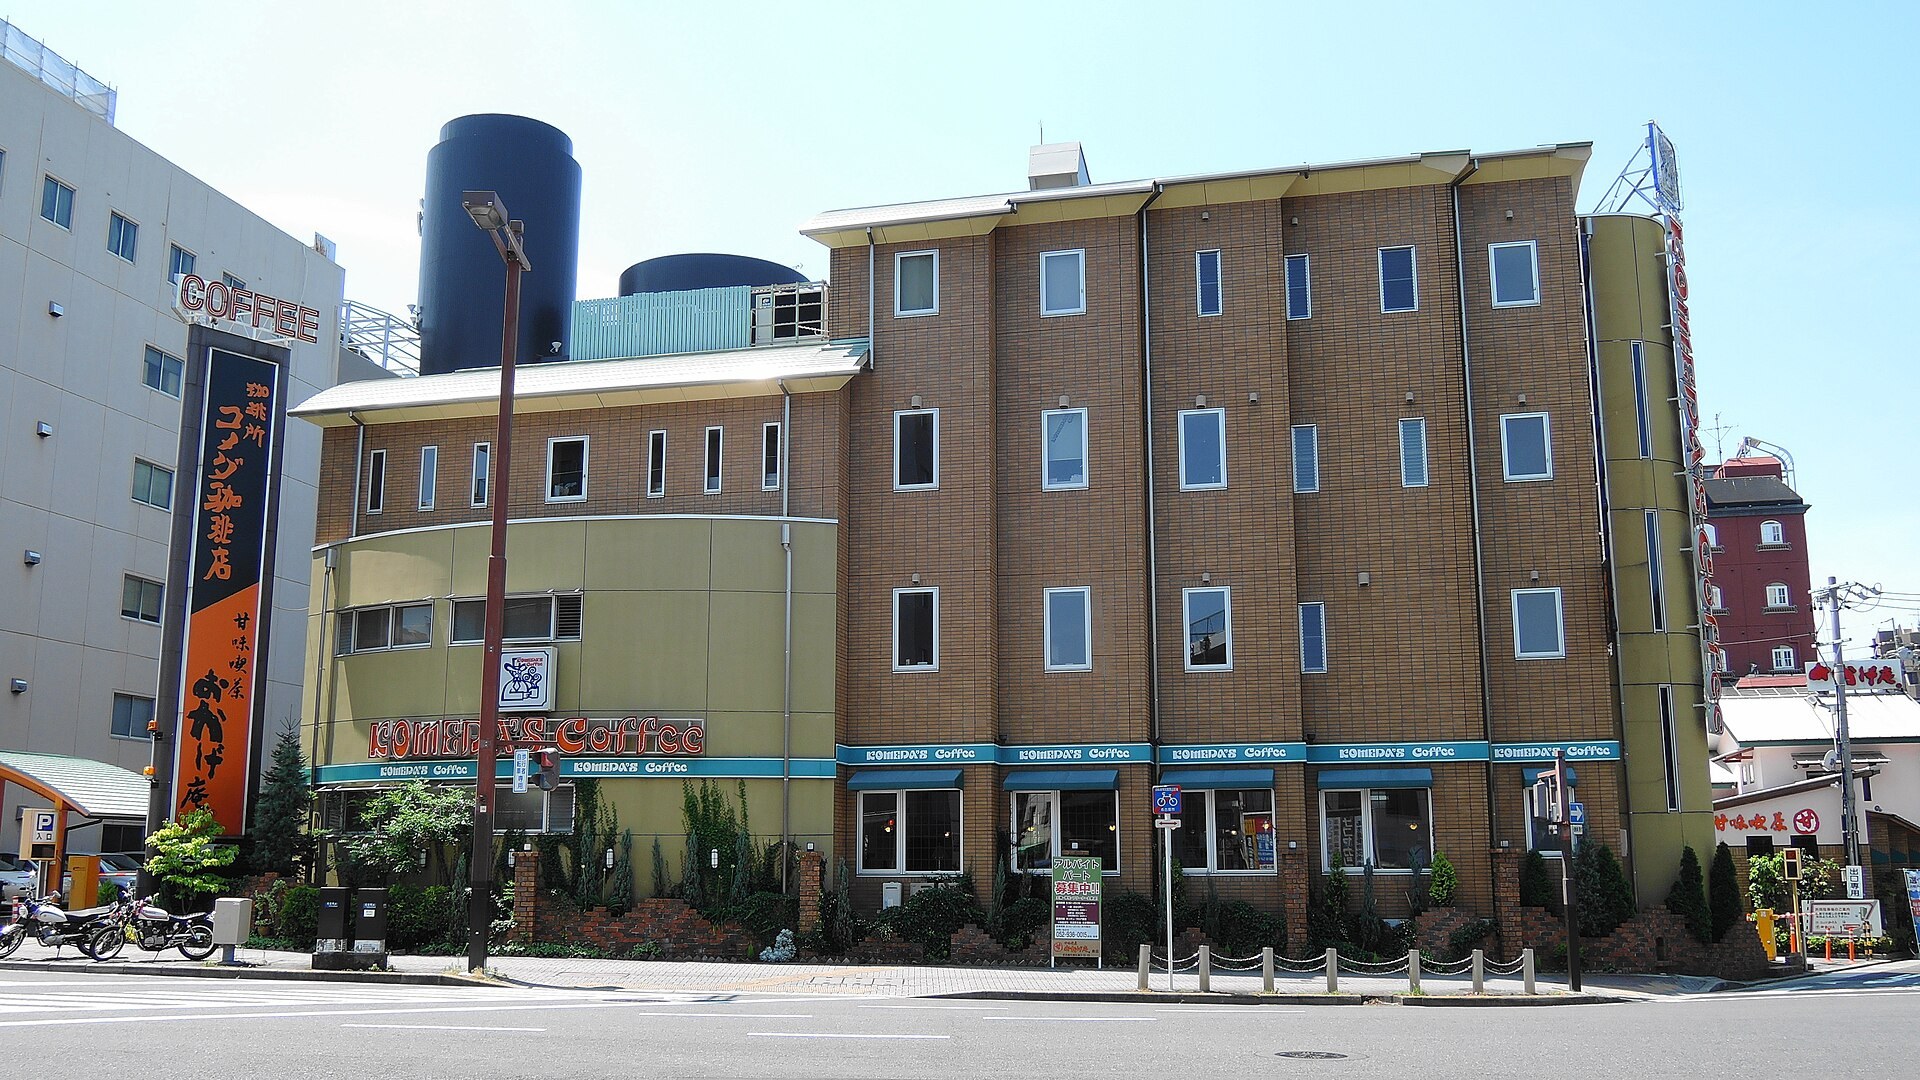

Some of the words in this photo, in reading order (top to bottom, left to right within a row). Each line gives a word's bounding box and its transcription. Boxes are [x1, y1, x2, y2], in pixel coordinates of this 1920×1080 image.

[181, 274, 319, 344] COFFEE
[243, 382, 269, 448] 珈琲所
[203, 405, 244, 580] コメダ珈琲店
[228, 612, 250, 699] 甘味喫茶
[180, 668, 229, 810] おかげ庵
[555, 716, 704, 756] Coffee
[866, 749, 928, 761] KOMEDA'S
[934, 748, 976, 759] Coffee
[1019, 749, 1082, 760] KOMEDA'S
[1088, 748, 1130, 759] Coffee
[1172, 749, 1237, 760] KOMEDA'S
[1244, 747, 1287, 758] Coffee
[1339, 748, 1405, 759] KOMEDA'S
[1412, 747, 1455, 757] Coffee
[1494, 747, 1561, 758] KOMEDA'S
[1566, 746, 1611, 756] Coffee
[380, 766, 428, 777] KOMEDA'S
[433, 764, 468, 775] Coffee
[573, 762, 638, 773] KOMEDA'S
[644, 761, 688, 773] Coffee
[38, 815, 52, 829] P
[1714, 811, 1788, 831] 甘味喫茶
[36, 832, 52, 841] 入口
[1054, 859, 1100, 869] アルバイト
[1849, 868, 1860, 896] 出口専用
